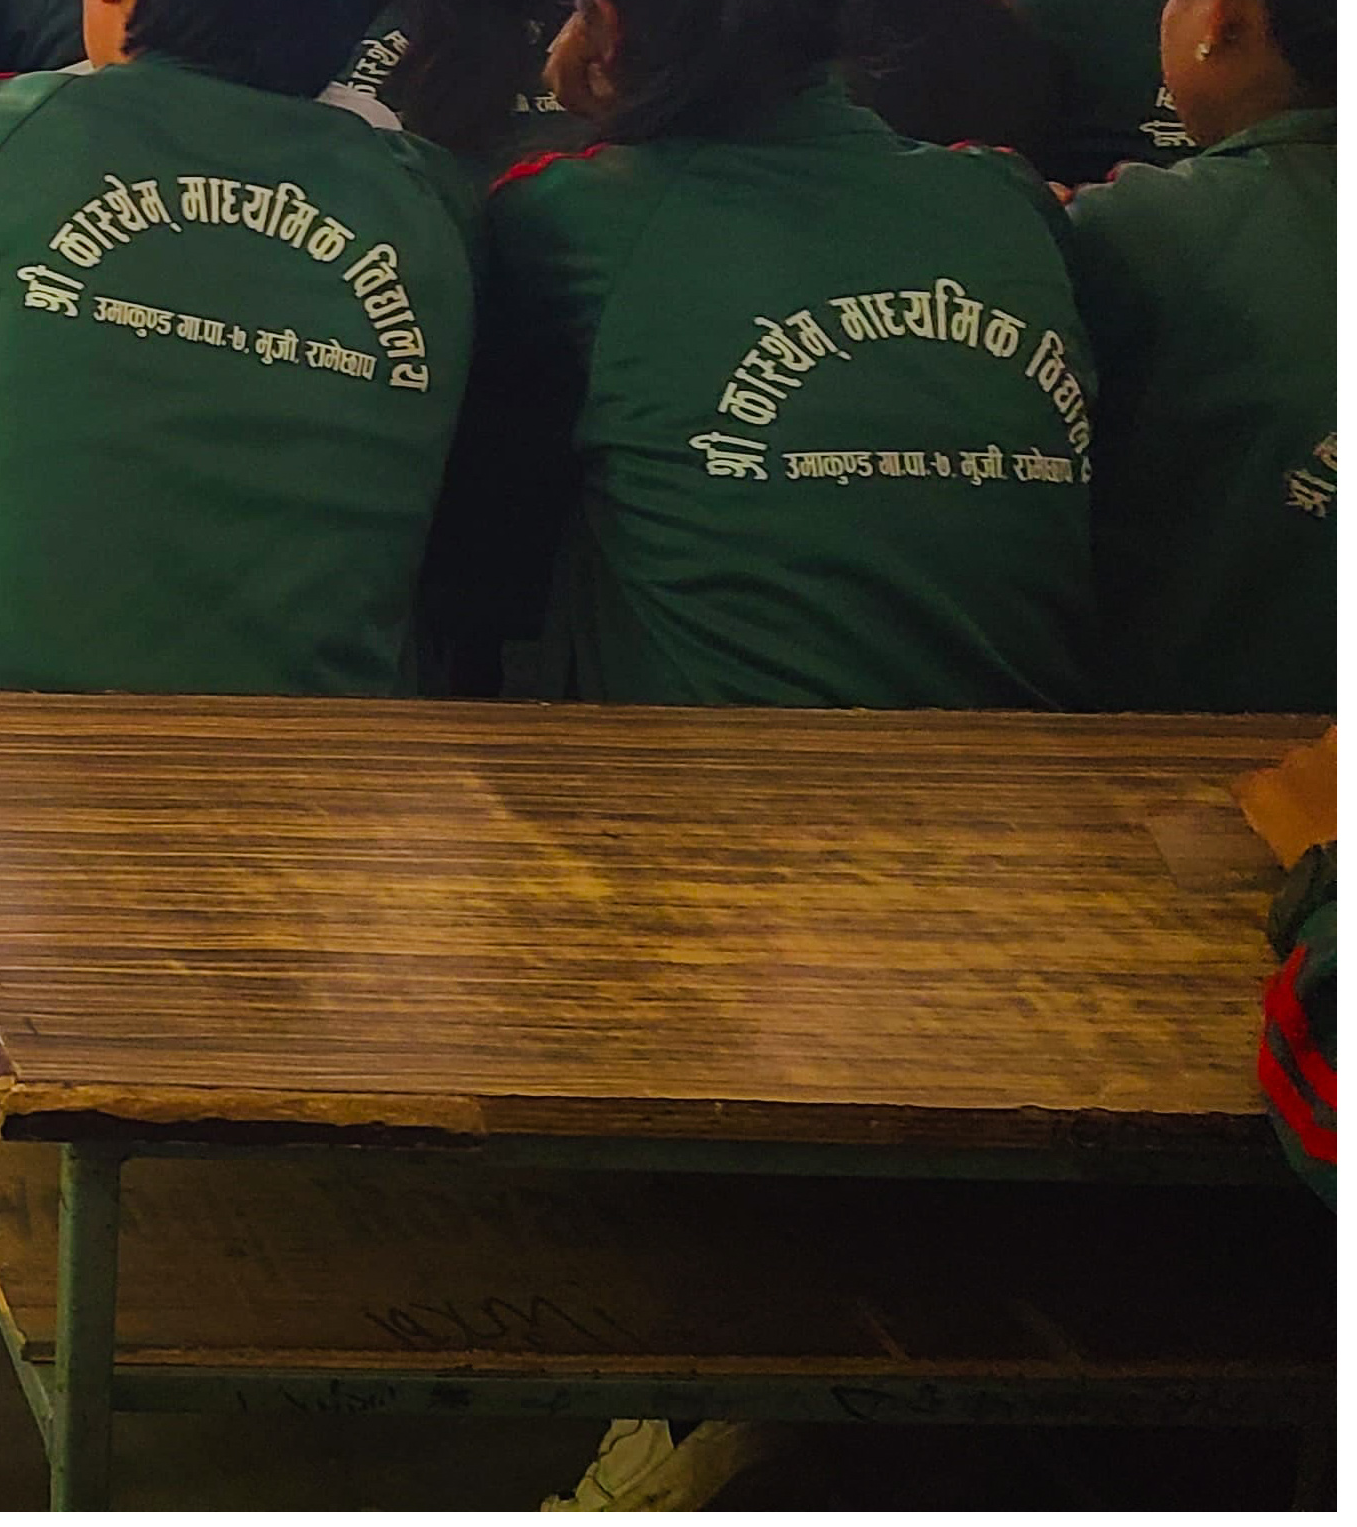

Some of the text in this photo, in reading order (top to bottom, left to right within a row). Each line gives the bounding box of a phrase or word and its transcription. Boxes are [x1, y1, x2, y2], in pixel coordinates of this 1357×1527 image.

[17, 265, 84, 318] श्री
[177, 176, 355, 262] माध्यमिक
[343, 242, 429, 393] विद्यालय
[93, 296, 176, 338] उमाकुण्ड
[305, 338, 377, 381] रामेछाप
[688, 431, 769, 481] श्री
[829, 278, 1027, 359] माध्यमिक
[781, 451, 874, 485] उमाकुण्ड
